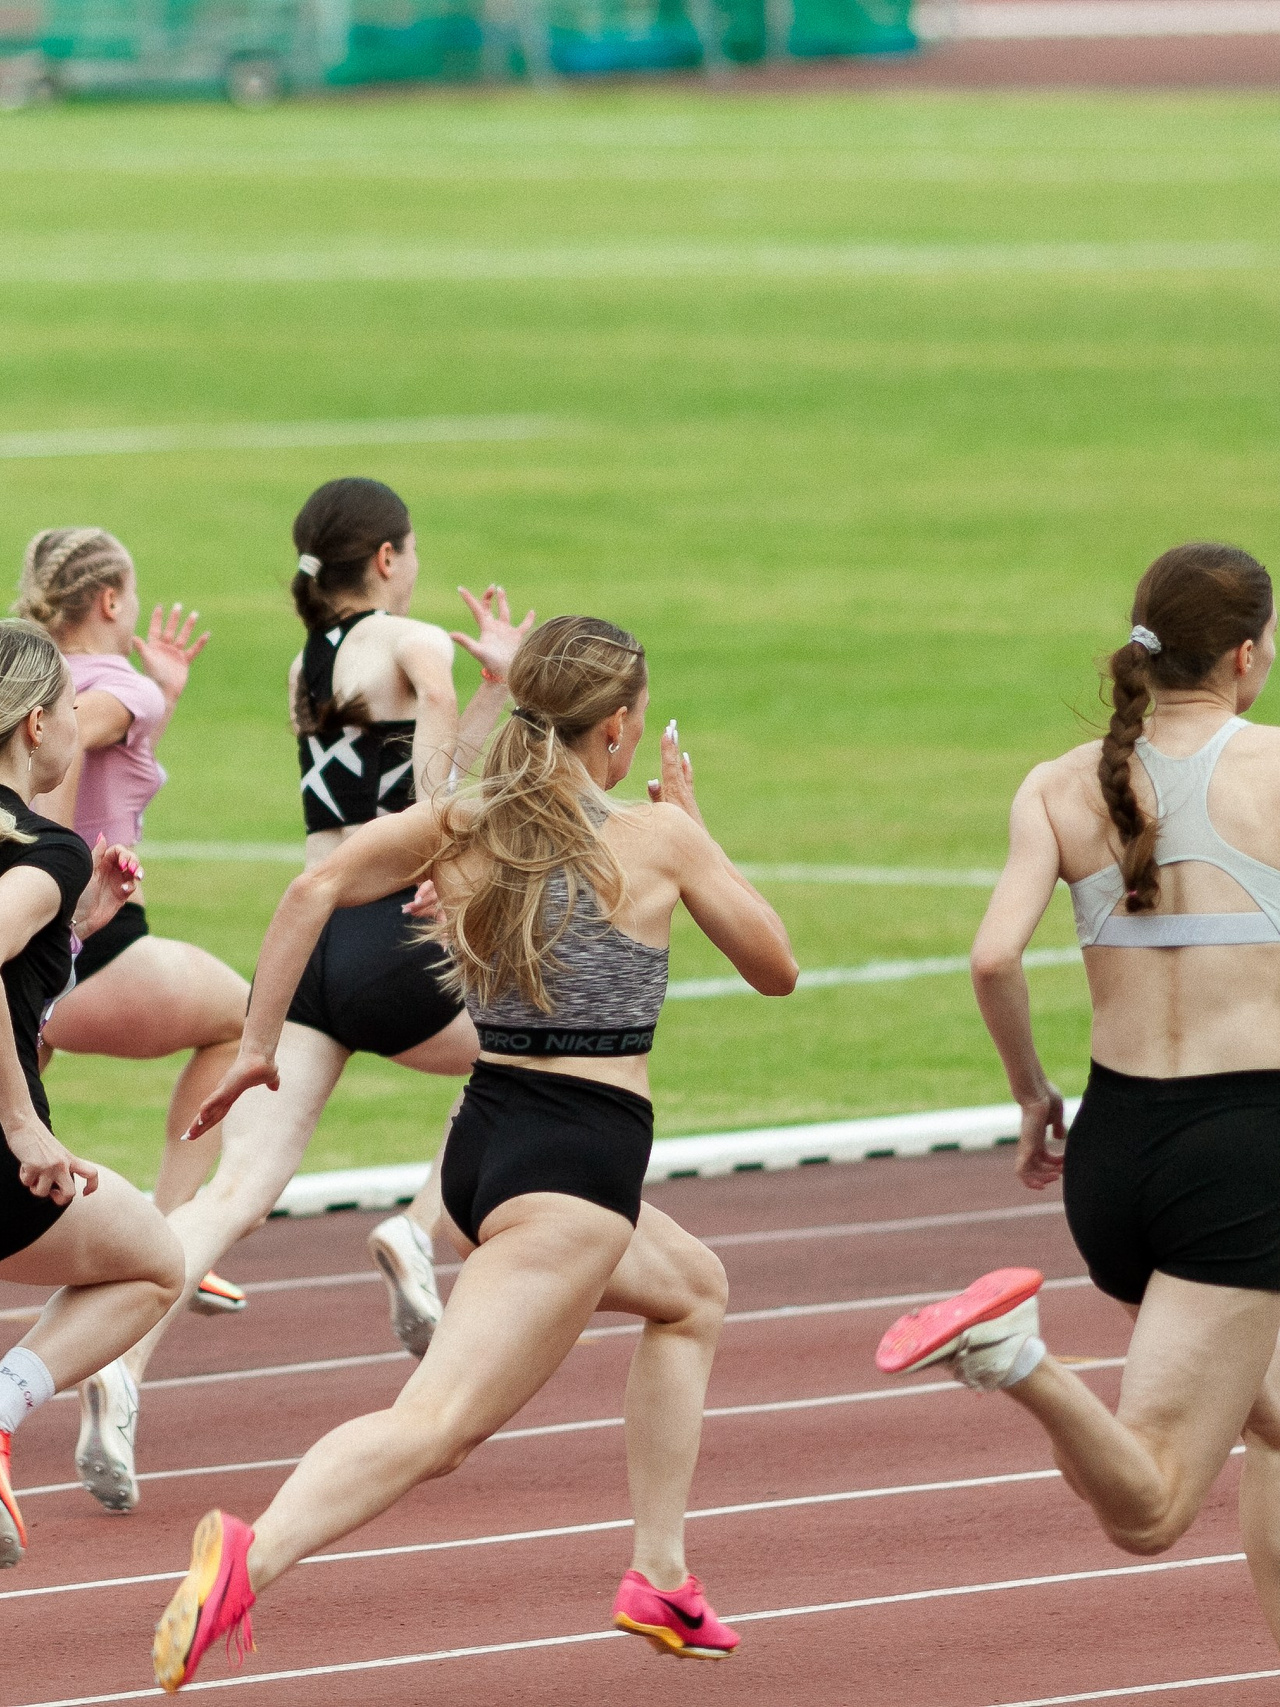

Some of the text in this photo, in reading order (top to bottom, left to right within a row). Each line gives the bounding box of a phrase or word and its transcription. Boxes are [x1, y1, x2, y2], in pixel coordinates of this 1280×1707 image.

[485, 1031, 531, 1050] PRO
[545, 1034, 619, 1051] NIKE
[621, 1032, 652, 1050] PR
